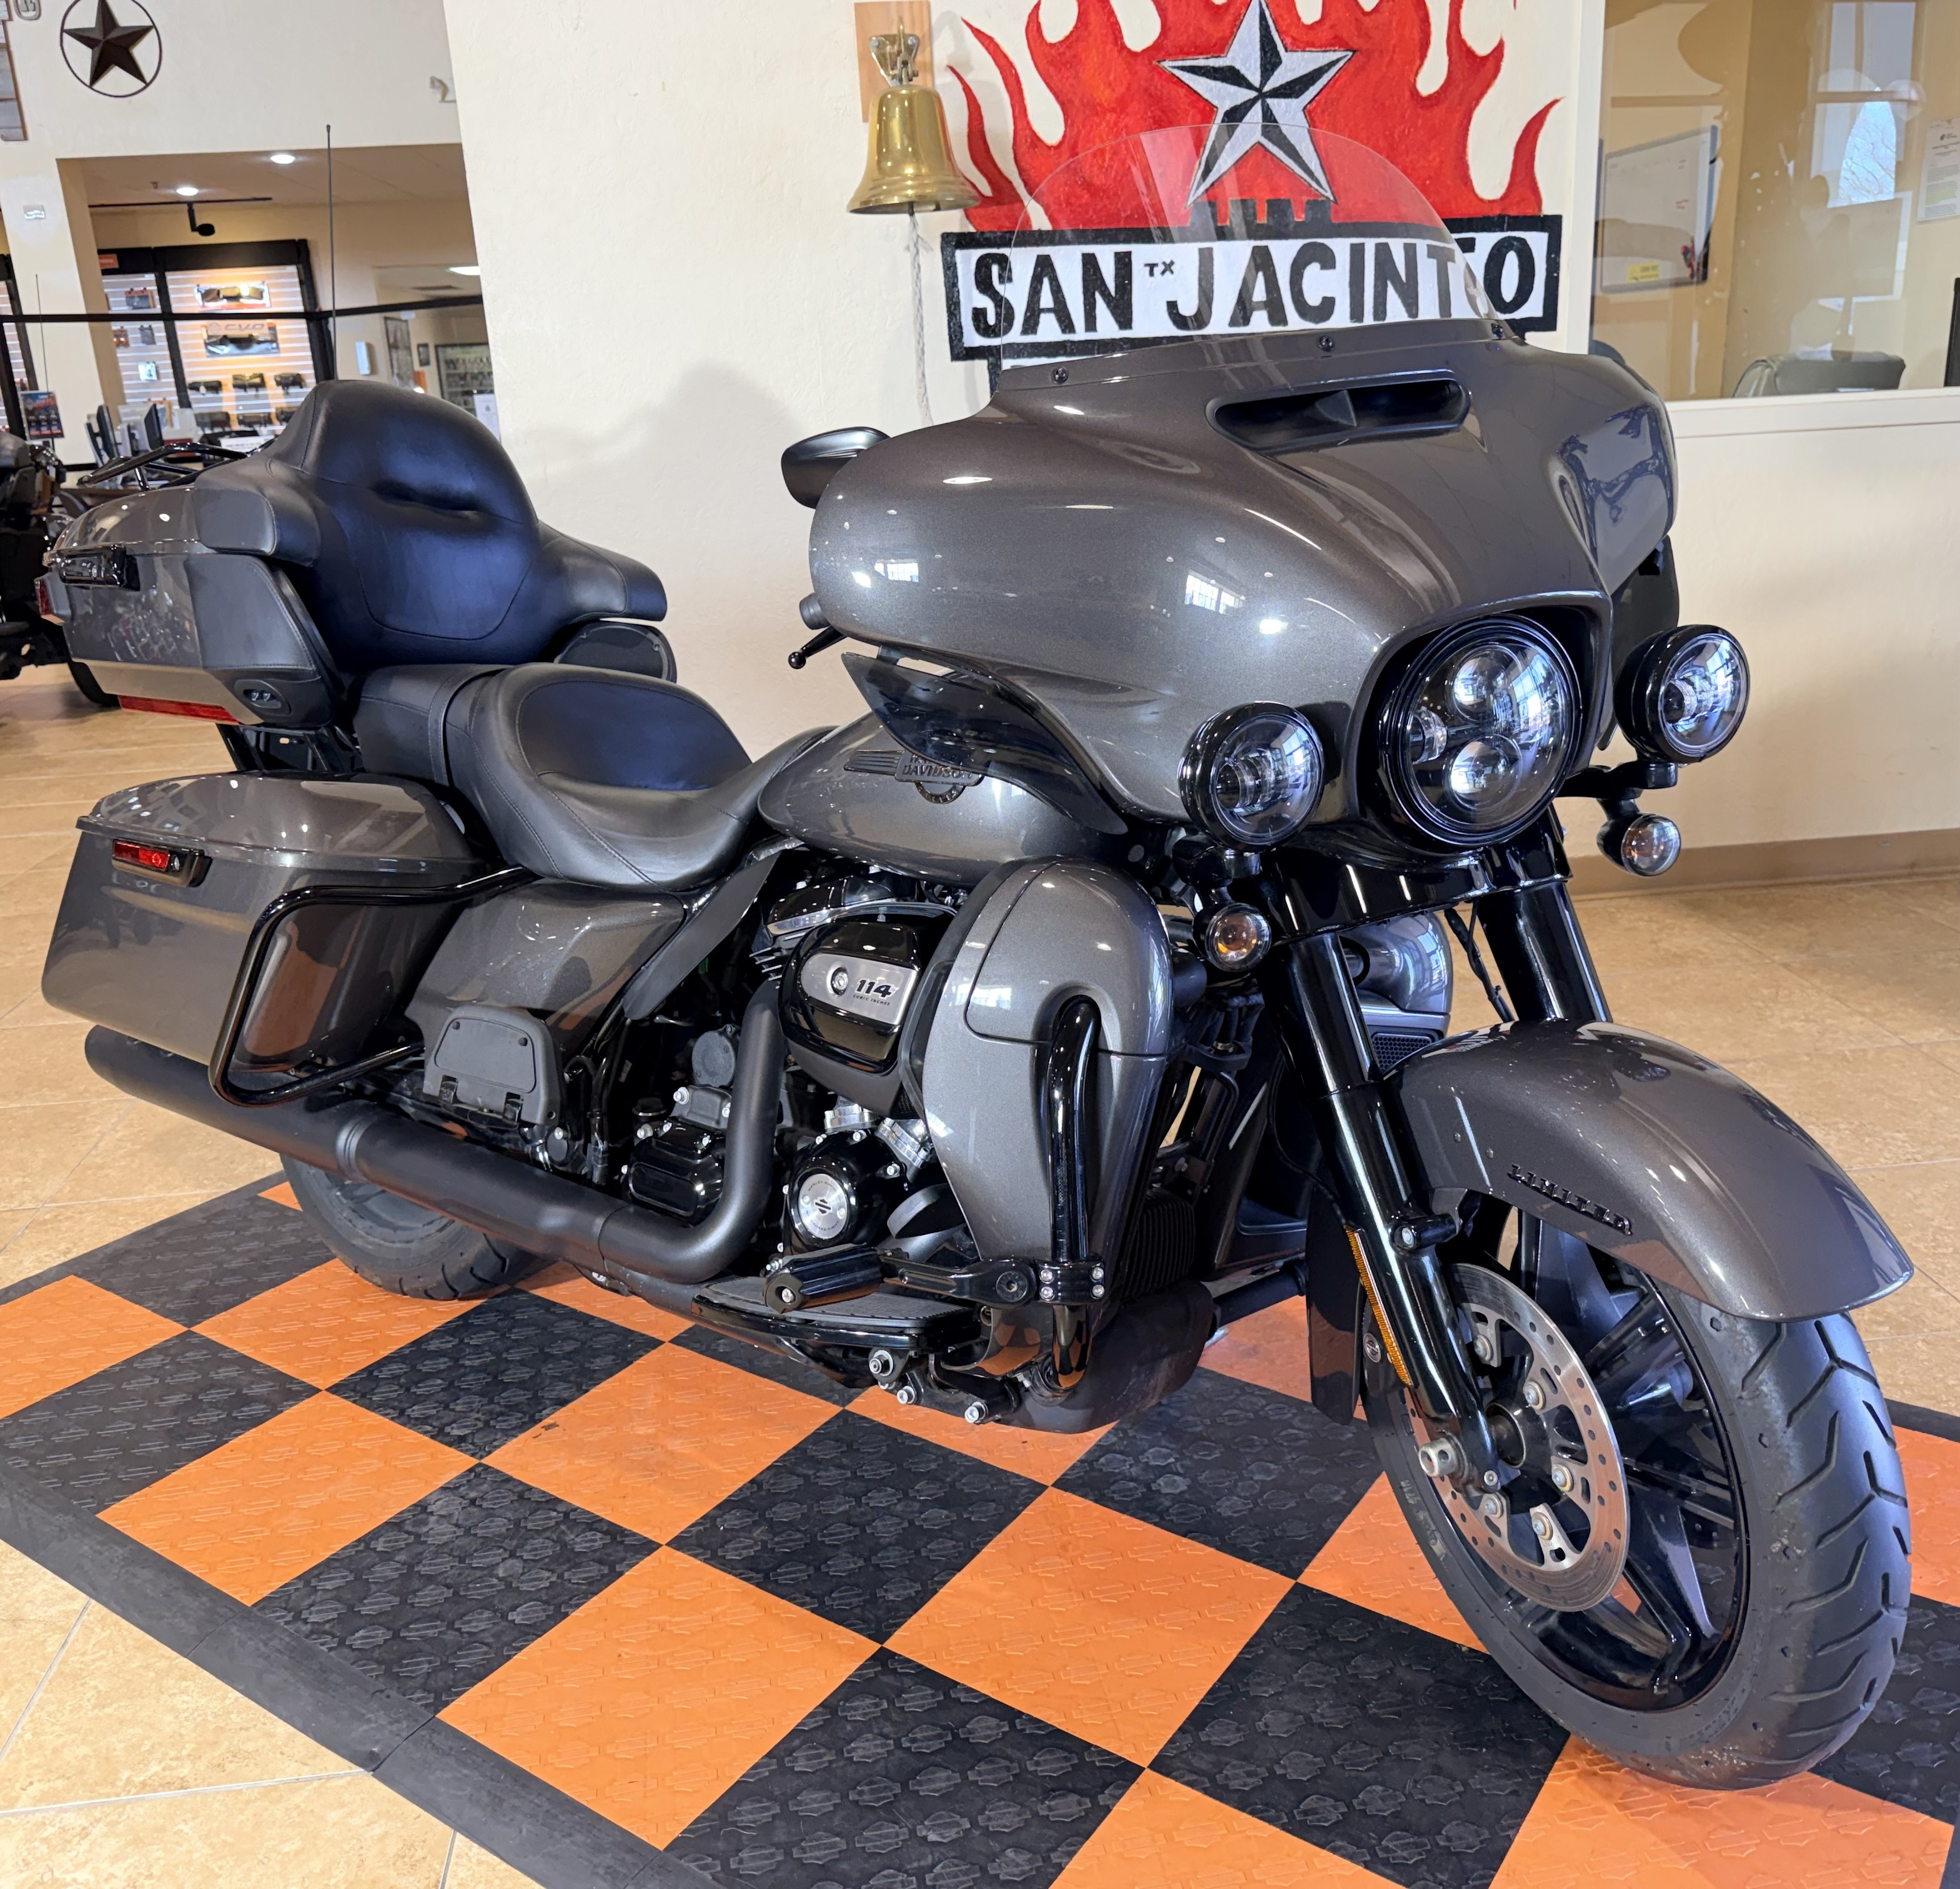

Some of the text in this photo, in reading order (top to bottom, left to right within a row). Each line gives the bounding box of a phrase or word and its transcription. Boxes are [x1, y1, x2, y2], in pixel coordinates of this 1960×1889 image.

[1144, 260, 1175, 277] TX
[1166, 236, 1535, 330] JACINTO
[971, 250, 1133, 338] SAN
[901, 764, 973, 780] DAVIDSON
[856, 979, 893, 998] 114
